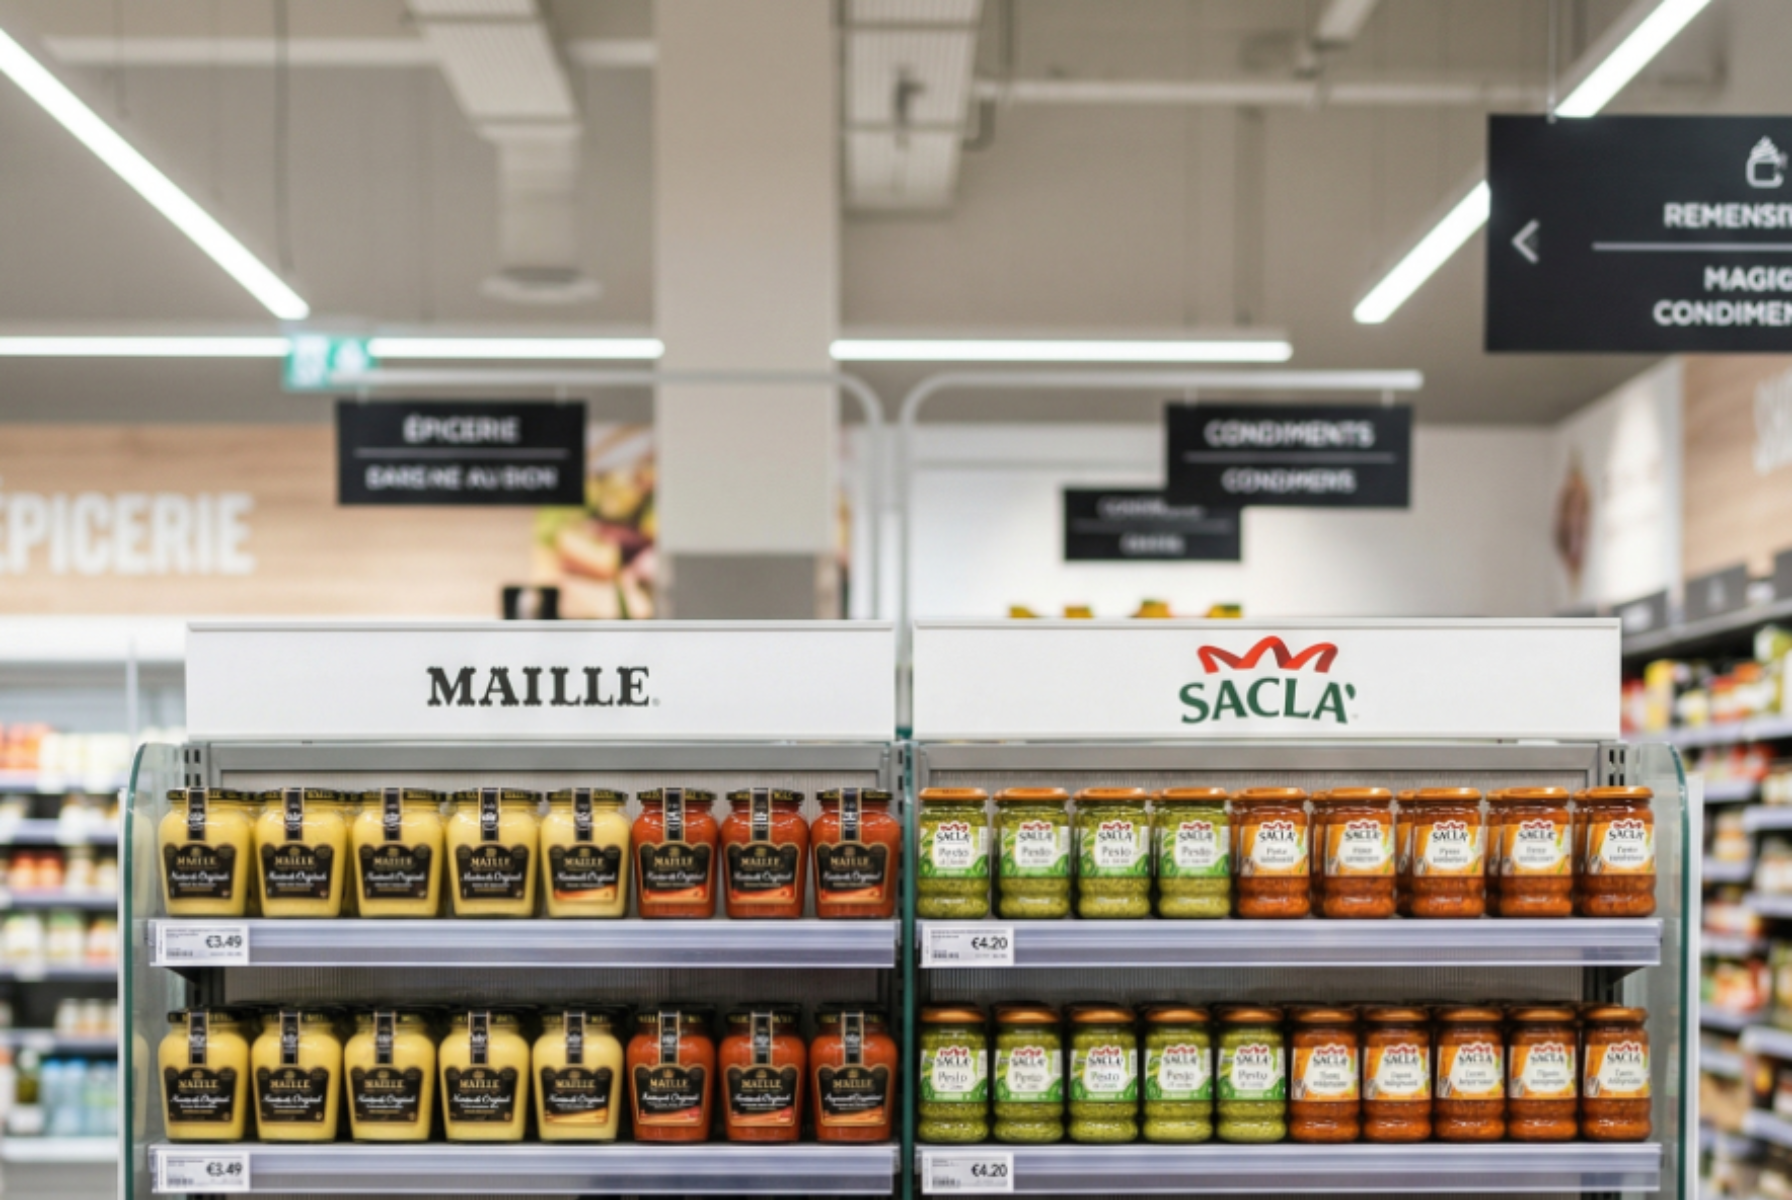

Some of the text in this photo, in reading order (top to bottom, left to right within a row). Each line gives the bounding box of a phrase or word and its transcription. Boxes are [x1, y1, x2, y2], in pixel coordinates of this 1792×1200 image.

[0, 491, 257, 574] PICERIE
[426, 666, 649, 706] MAILLE
[206, 936, 242, 948] €3.49
[971, 938, 1007, 949] €4.20
[207, 1163, 242, 1175] €3.49
[971, 1165, 1007, 1176] €4.20
